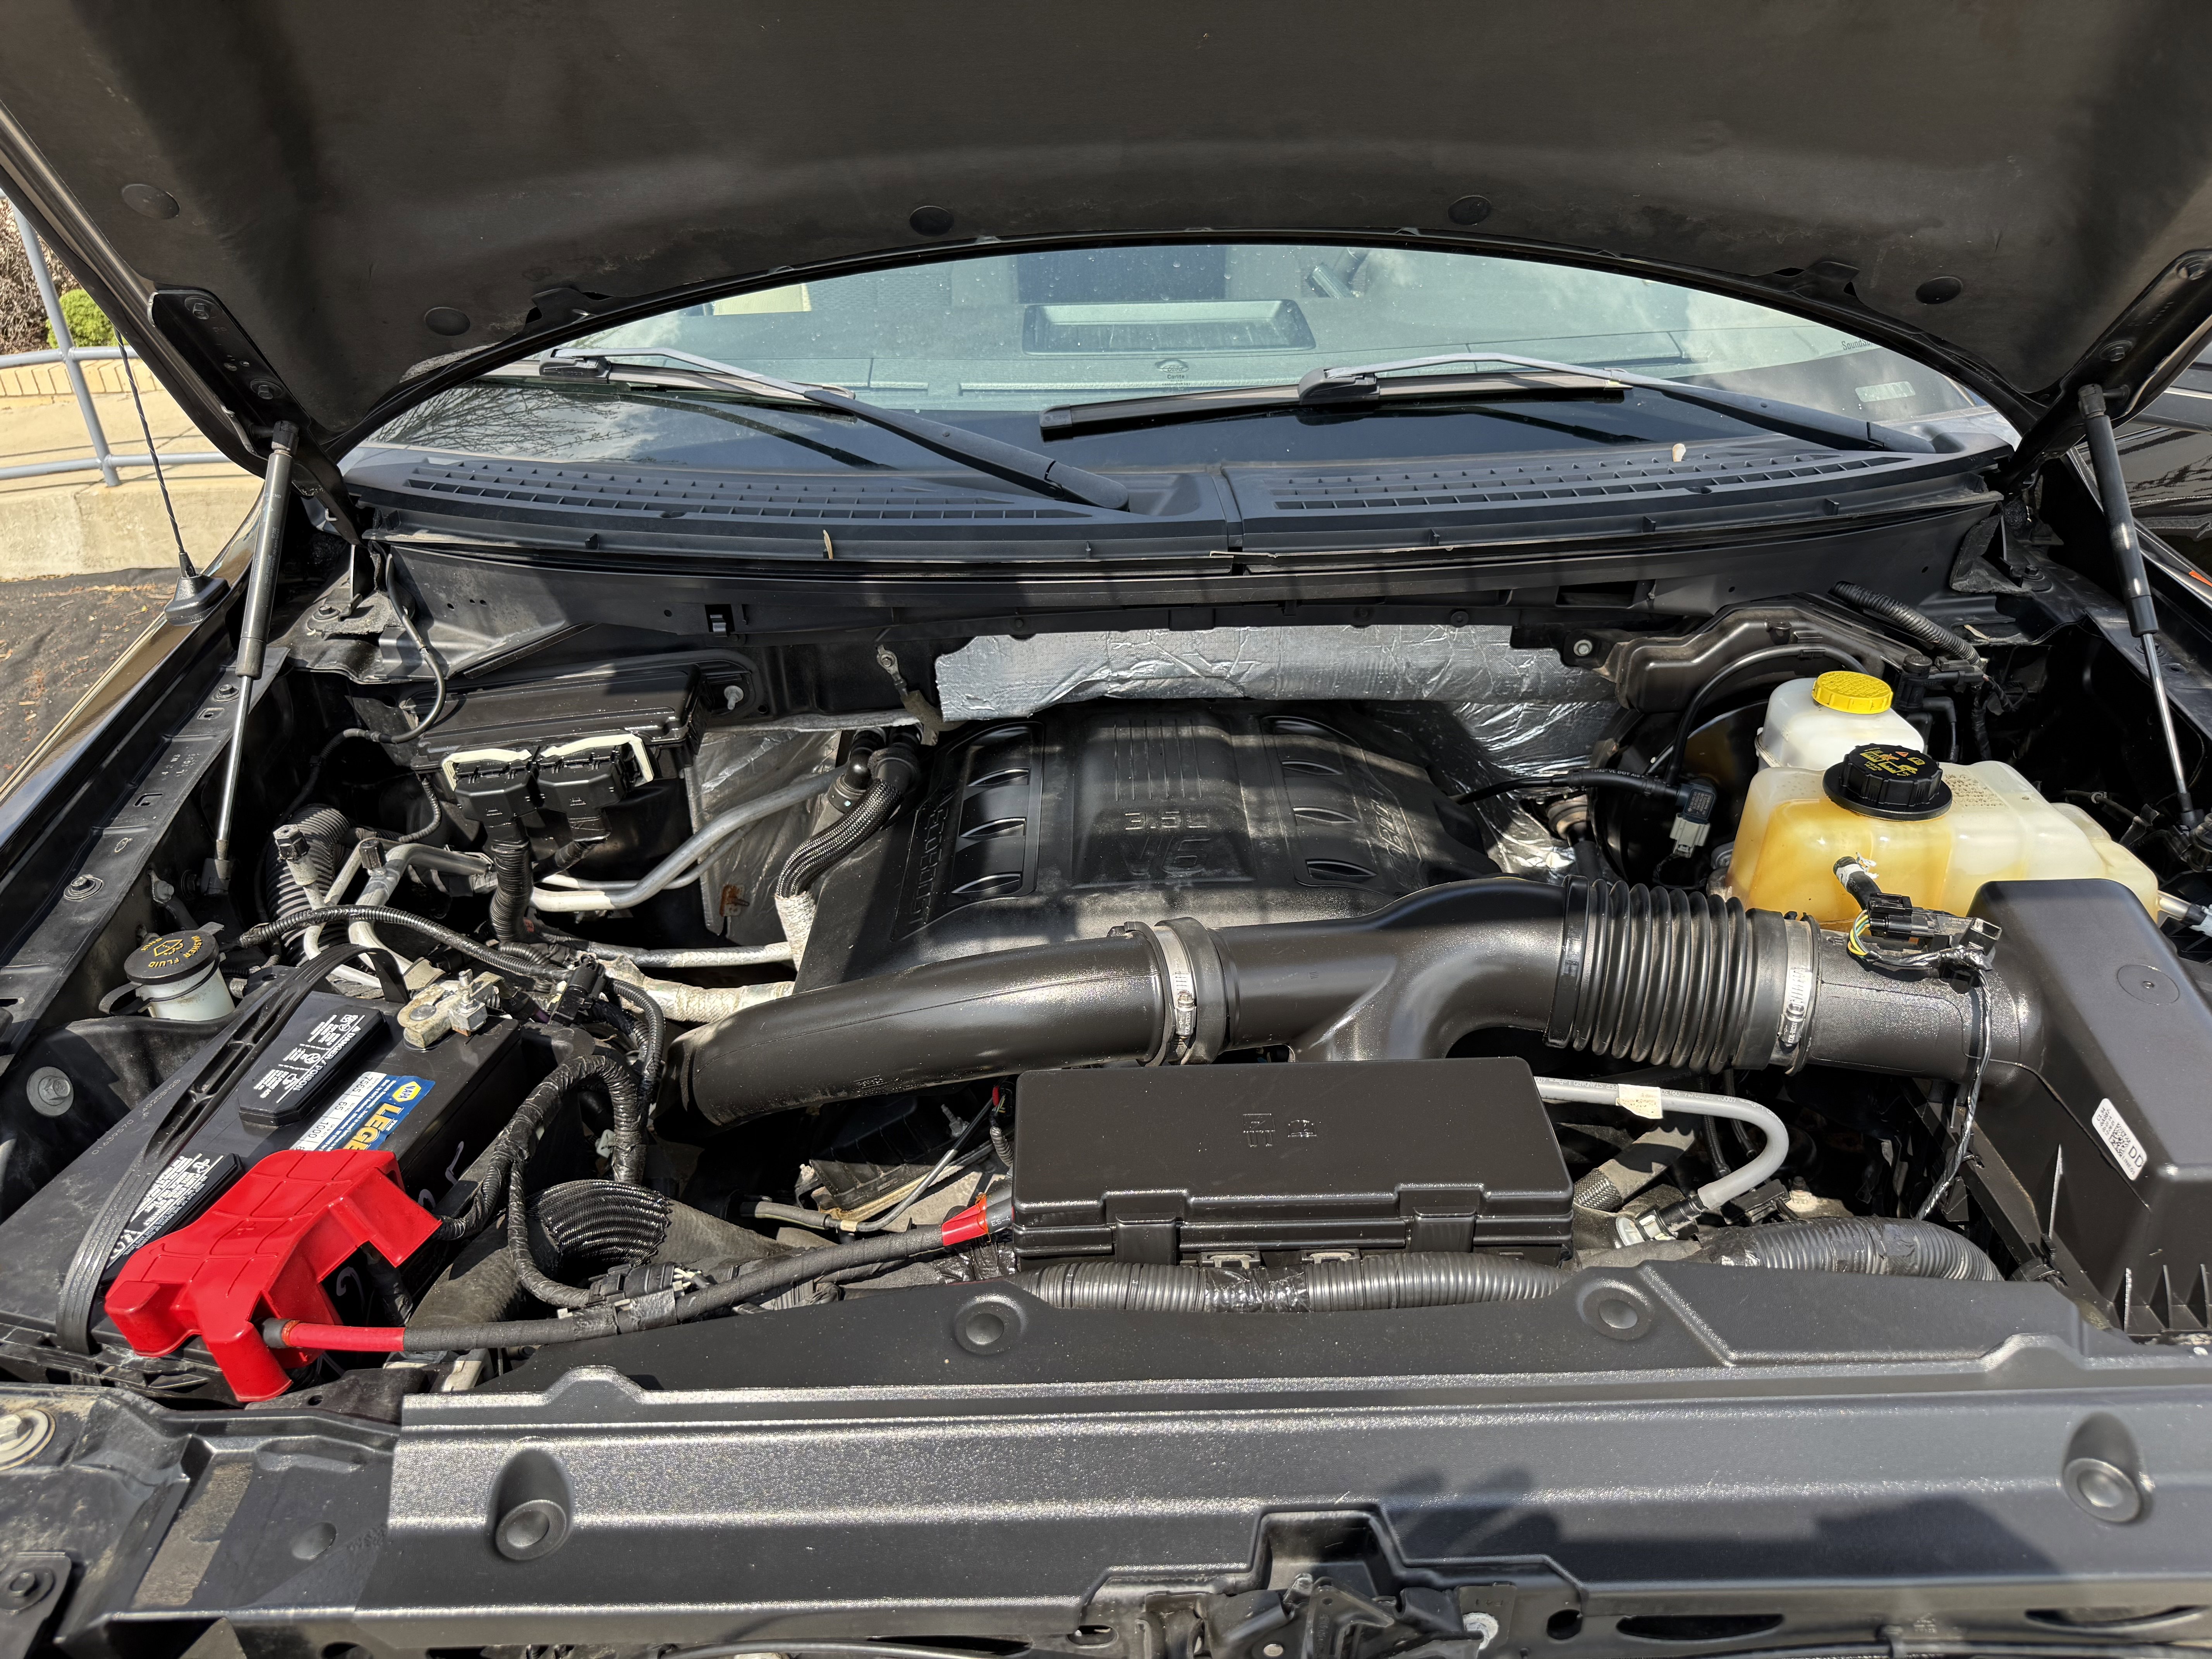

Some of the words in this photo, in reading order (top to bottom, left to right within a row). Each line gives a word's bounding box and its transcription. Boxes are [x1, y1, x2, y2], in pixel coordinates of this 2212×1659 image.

[1125, 809, 1208, 831] 3.5L
[1115, 834, 1211, 876] V6
[141, 937, 163, 951] ONLY
[183, 935, 202, 958] WASHER
[148, 957, 179, 967] FLUID
[326, 1032, 356, 1060] DANGER
[293, 1065, 323, 1091] POISON
[352, 1075, 373, 1093] 7565
[1573, 1080, 1603, 1089] STANDARD
[396, 1084, 417, 1100] NAPA
[334, 1101, 348, 1111] 65
[308, 1120, 329, 1139] 1000
[342, 1101, 405, 1155] LEGE
[2128, 1144, 2144, 1170] DD
[167, 1171, 190, 1190] MEDICAL
[182, 1173, 201, 1187] FLUSH
[155, 1189, 171, 1201] HELP
[171, 1187, 187, 1198] EYES
[141, 1198, 175, 1226] IMMEDIATELY
[142, 1200, 159, 1213] FAST
[164, 1206, 177, 1215] VENT
[154, 1215, 167, 1225] CAPS
[159, 1213, 175, 1225] REACH
[143, 1225, 157, 1235] TIGHT
[134, 1235, 146, 1244] AND
[135, 1231, 156, 1249] CHILDREN
[122, 1244, 137, 1255] LEVEL
